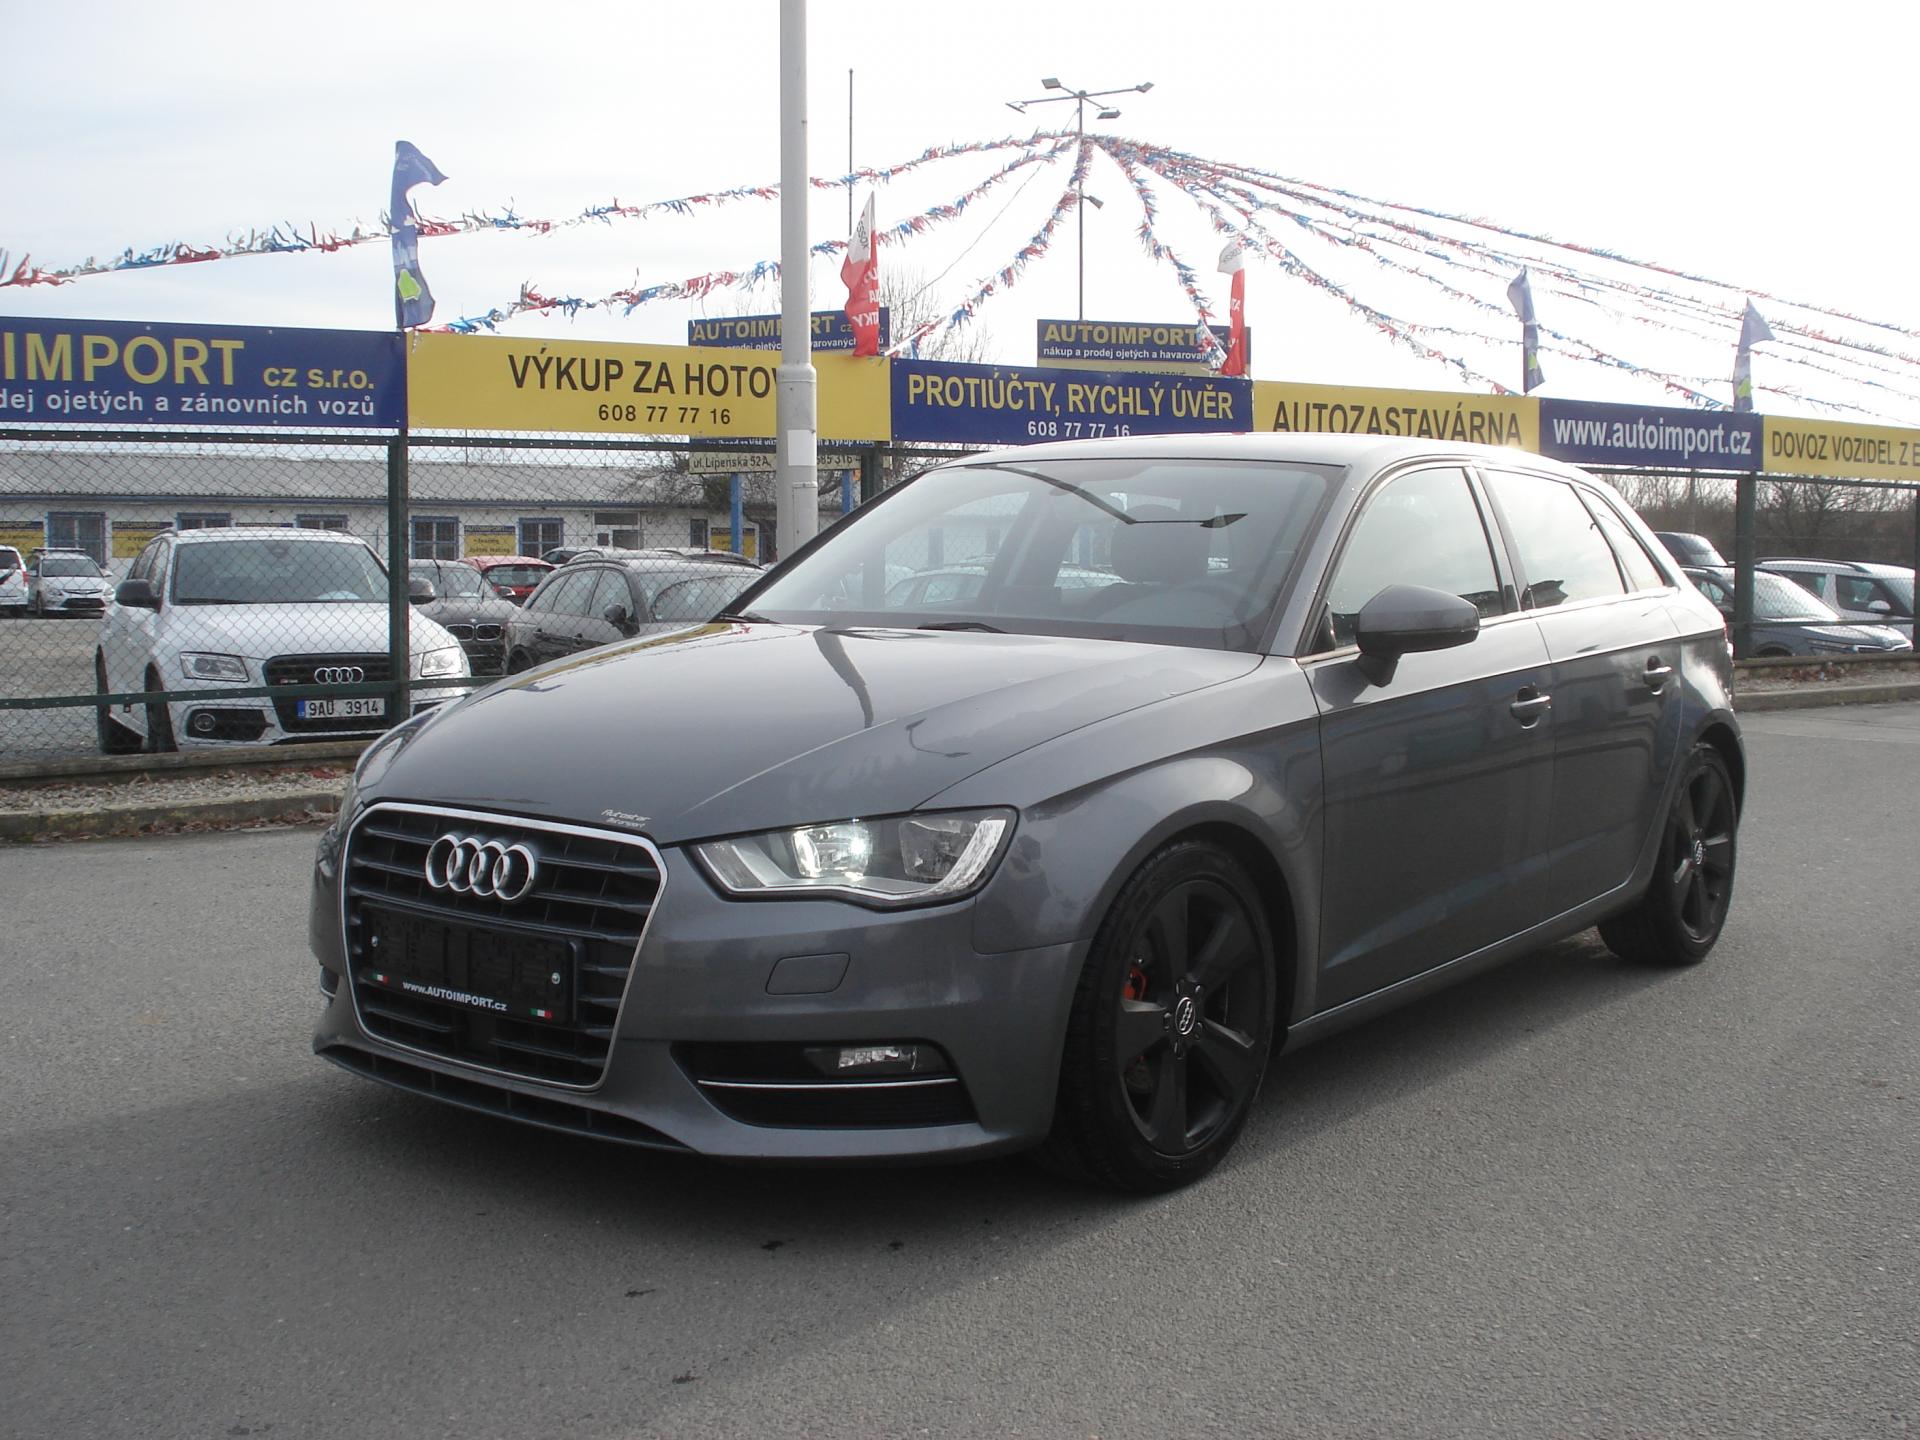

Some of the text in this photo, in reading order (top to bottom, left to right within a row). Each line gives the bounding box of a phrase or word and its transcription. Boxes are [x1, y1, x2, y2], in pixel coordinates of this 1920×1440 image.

[1044, 324, 1197, 346] AUTOIMPORT
[3, 332, 375, 389] IMPORT cz s.r.o.
[1043, 346, 1073, 358] nákup
[1083, 348, 1113, 359] prodej
[1116, 348, 1149, 360] ojetých
[1152, 350, 1158, 358] a
[508, 347, 777, 399] VÝKUP ZA HOTO
[47, 390, 143, 415] ojetých
[155, 395, 169, 412] a
[181, 393, 307, 415] zánovních
[318, 395, 375, 415] vozů
[908, 372, 1234, 420] PROTIÚČTY, RYCHLÝ ÚVĚR
[598, 404, 731, 425] 608 77 77 16
[1027, 421, 1130, 439] 608 77 77 16
[1272, 400, 1522, 447] AUTOZASTAVÁRNA
[1553, 416, 1752, 460] www.autoimport.cz
[1772, 431, 1828, 460] DOVOZ
[1832, 435, 1896, 465] VOZIDEL
[1899, 441, 1908, 466] Z
[308, 700, 379, 716] 9AU 3914
[402, 981, 508, 1012] www.AUTOIMPORT.cz
